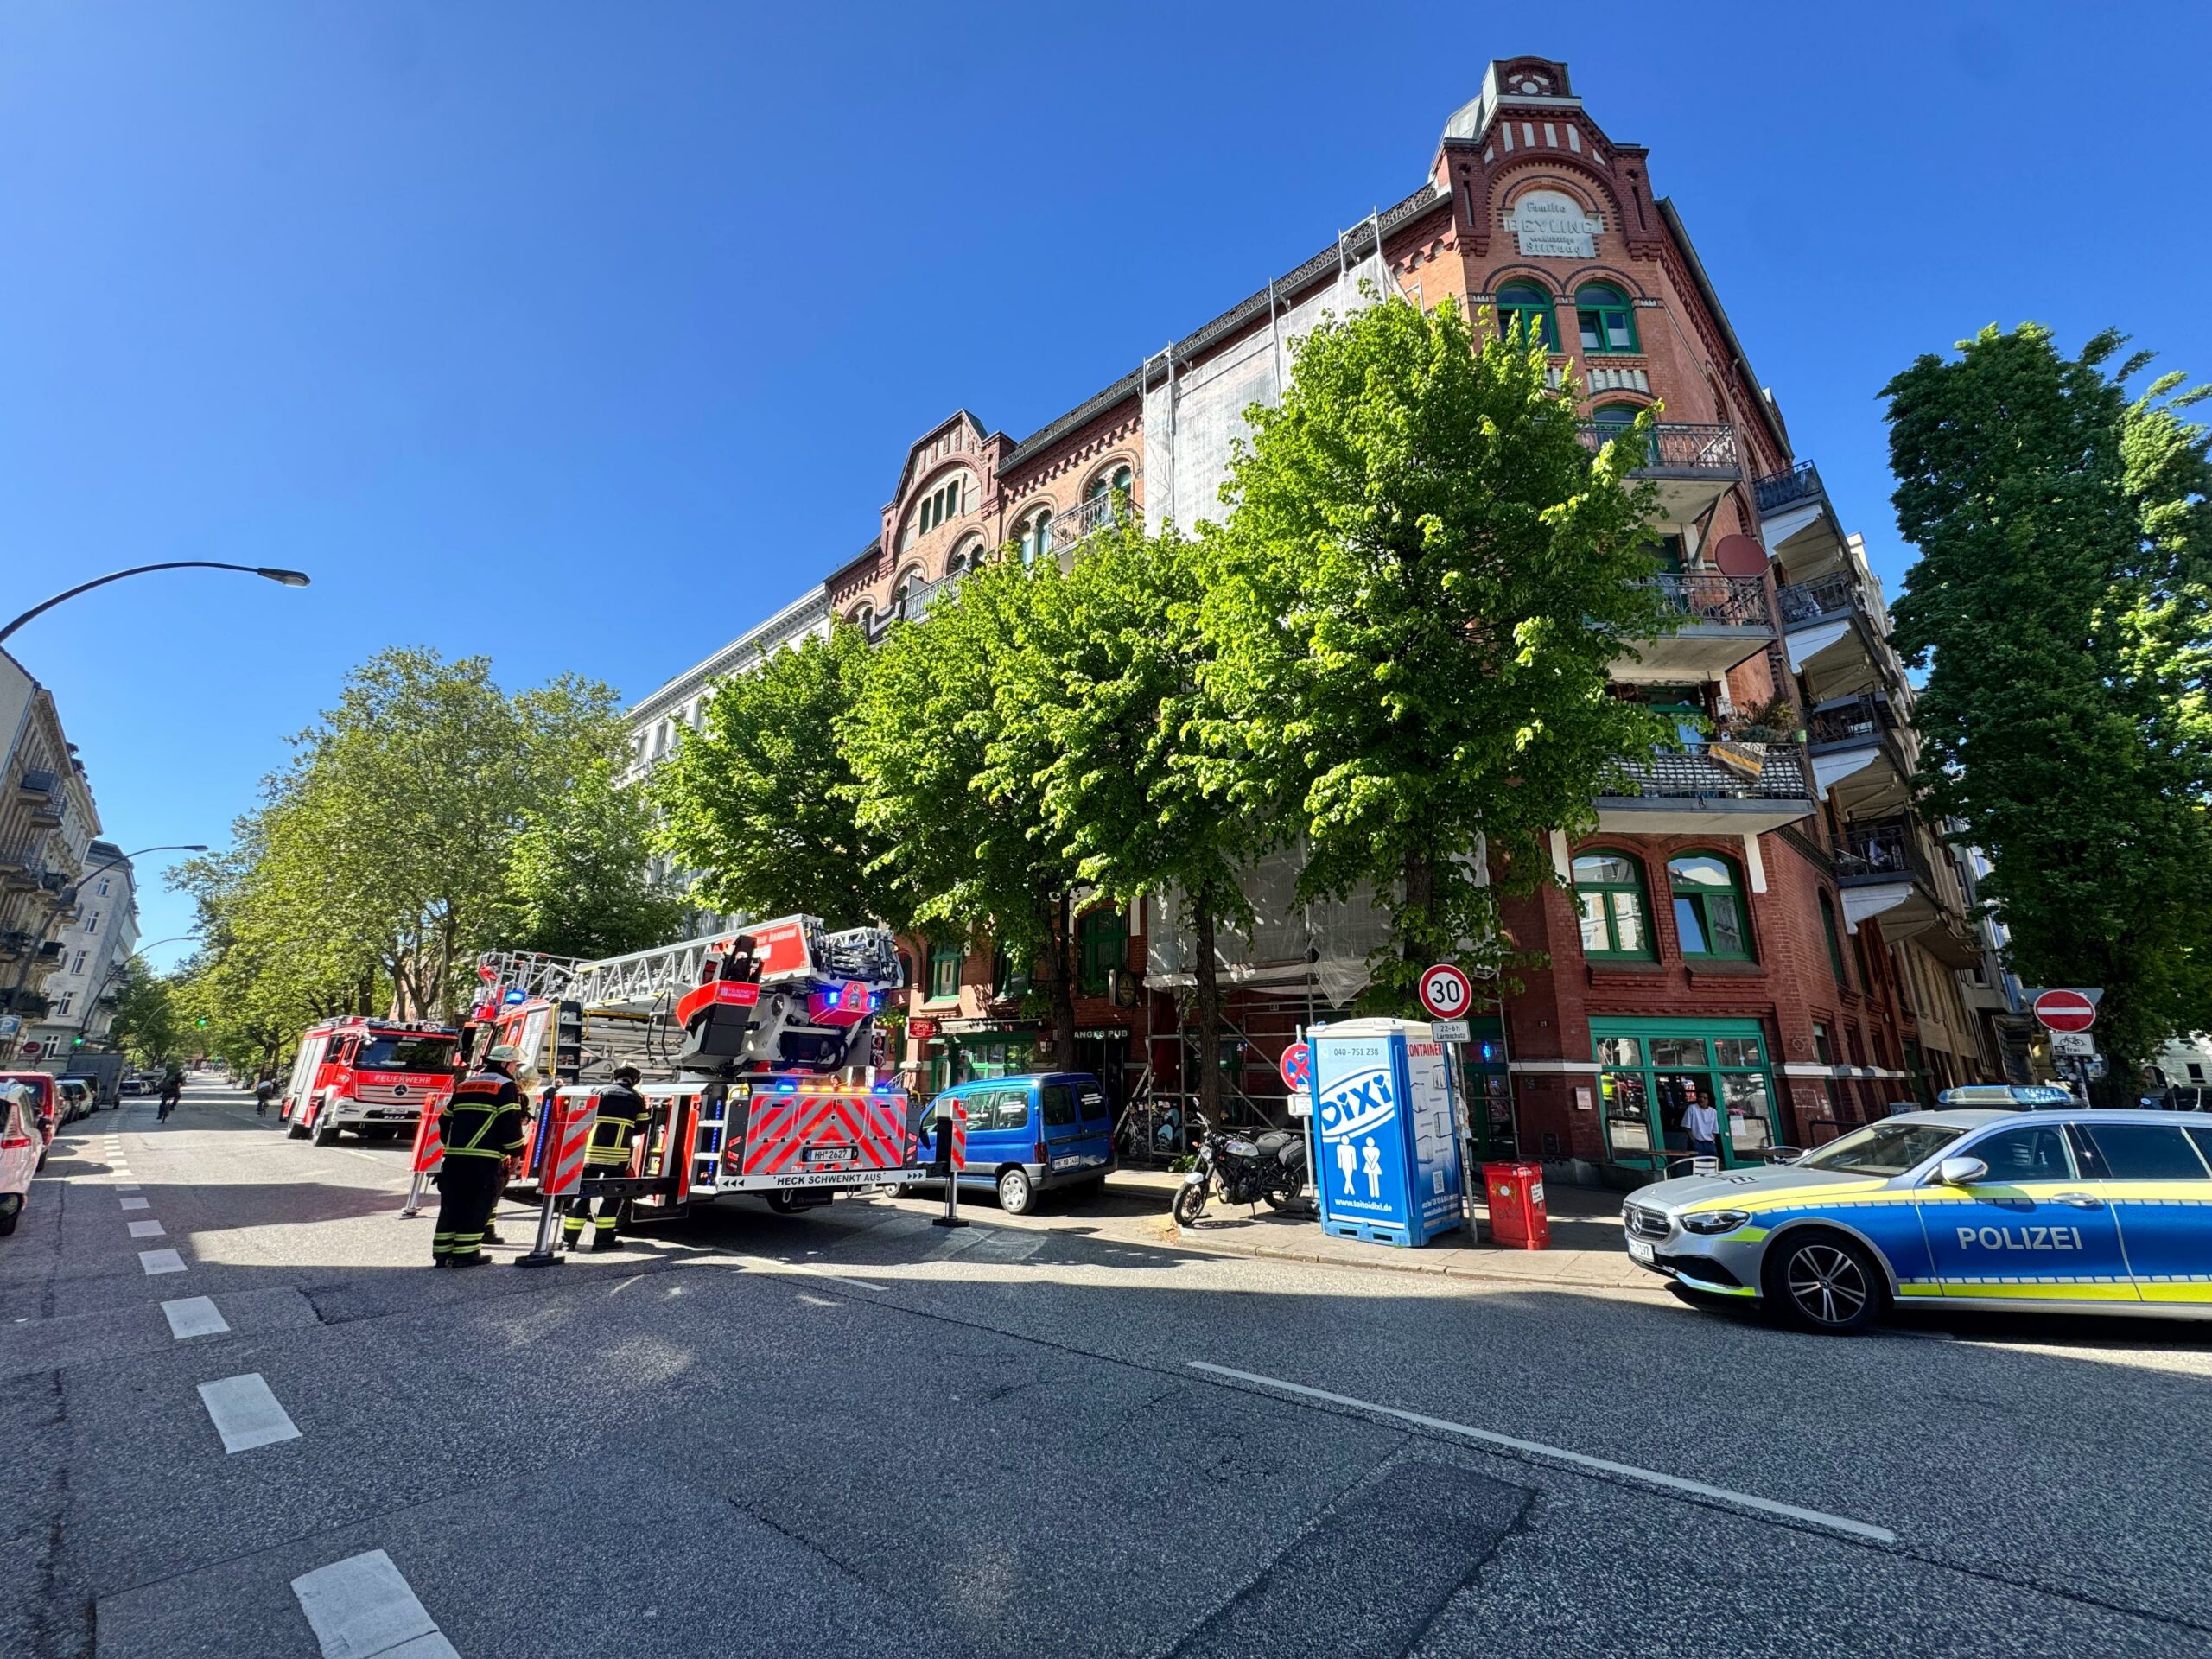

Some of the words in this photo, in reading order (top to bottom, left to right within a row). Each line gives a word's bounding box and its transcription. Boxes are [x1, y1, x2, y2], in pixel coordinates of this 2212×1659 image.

[1431, 980, 1460, 1003] 30
[1108, 1029, 1128, 1038] PUB
[1366, 1047, 1379, 1056] 238
[374, 1074, 432, 1084] FEUERWEHR
[814, 1151, 825, 1160] HH
[829, 1149, 848, 1159] 2627
[777, 1176, 804, 1185] HECK
[808, 1174, 861, 1185] SCHWENKT
[863, 1173, 882, 1182] AUS
[1334, 1198, 1393, 1212] www.toitoidixi.de
[1956, 1226, 2083, 1250] POLIZEI
